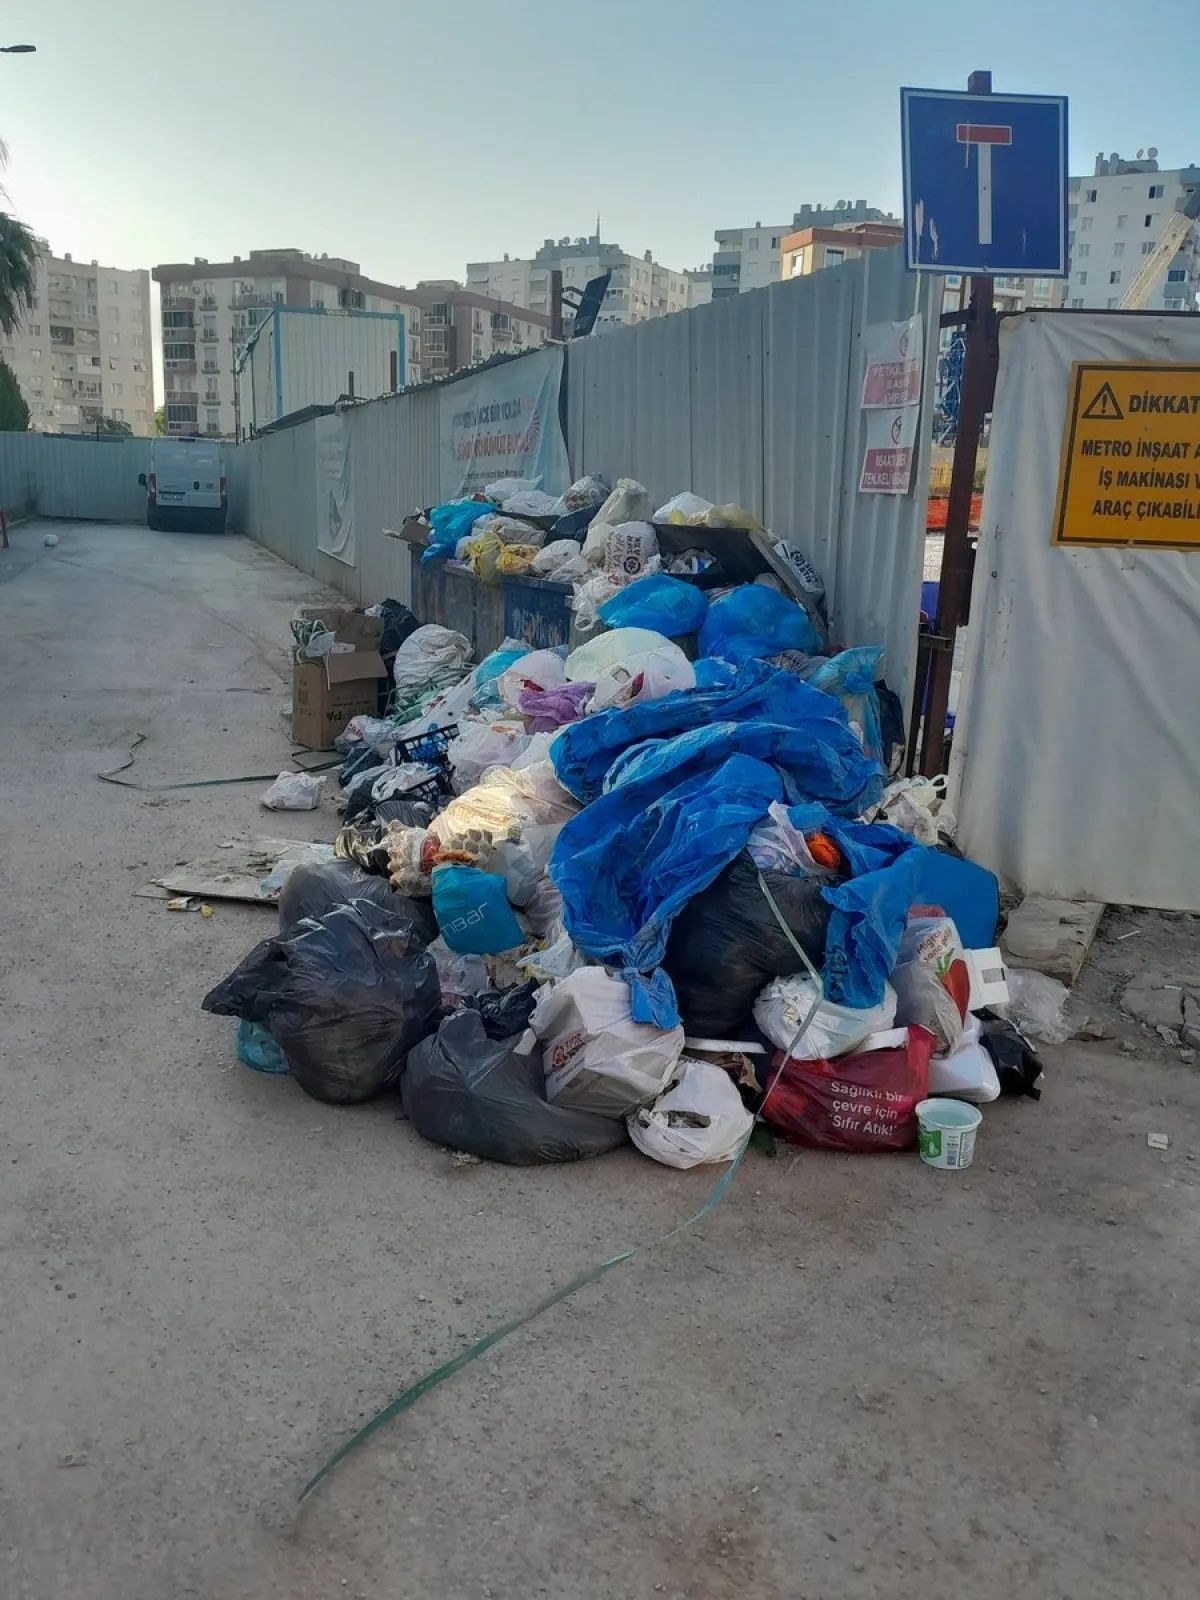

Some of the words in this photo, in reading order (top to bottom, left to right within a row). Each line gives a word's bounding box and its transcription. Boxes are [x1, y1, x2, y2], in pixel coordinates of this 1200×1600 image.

[1081, 439, 1132, 457] METRO
[1136, 437, 1191, 462] İNŞAAT
[1098, 466, 1112, 490] İŞ
[1116, 467, 1190, 489] MAKİNASI
[1092, 499, 1131, 520] ARAÇ
[831, 1081, 882, 1099] Sağlıklı
[885, 1091, 904, 1103] bir
[832, 1100, 872, 1115] çevre
[875, 1104, 898, 1120] için
